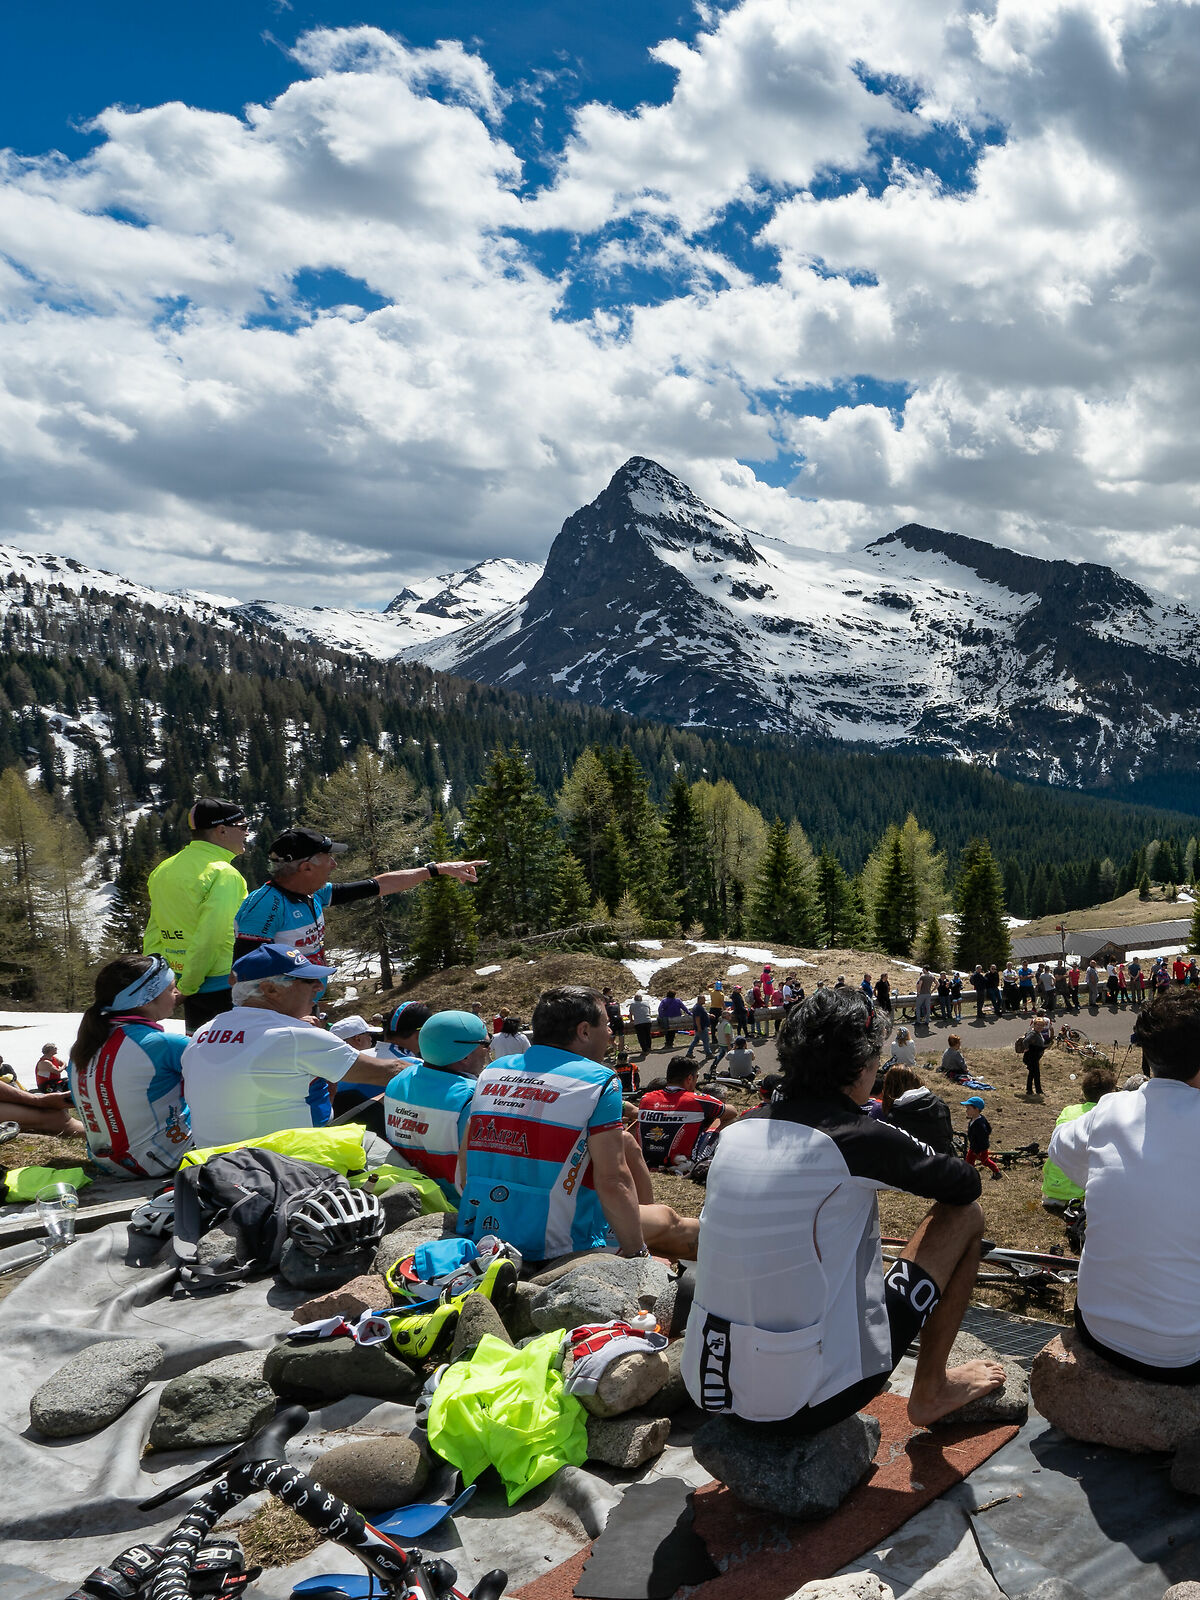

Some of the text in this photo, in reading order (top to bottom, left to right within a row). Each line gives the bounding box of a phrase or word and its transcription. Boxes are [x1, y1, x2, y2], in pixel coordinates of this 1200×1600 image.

[197, 1030, 245, 1044] CUBA
[492, 1098, 526, 1109] Verona
[123, 1547, 155, 1570] SIDI
[196, 1547, 234, 1562] SIDI
